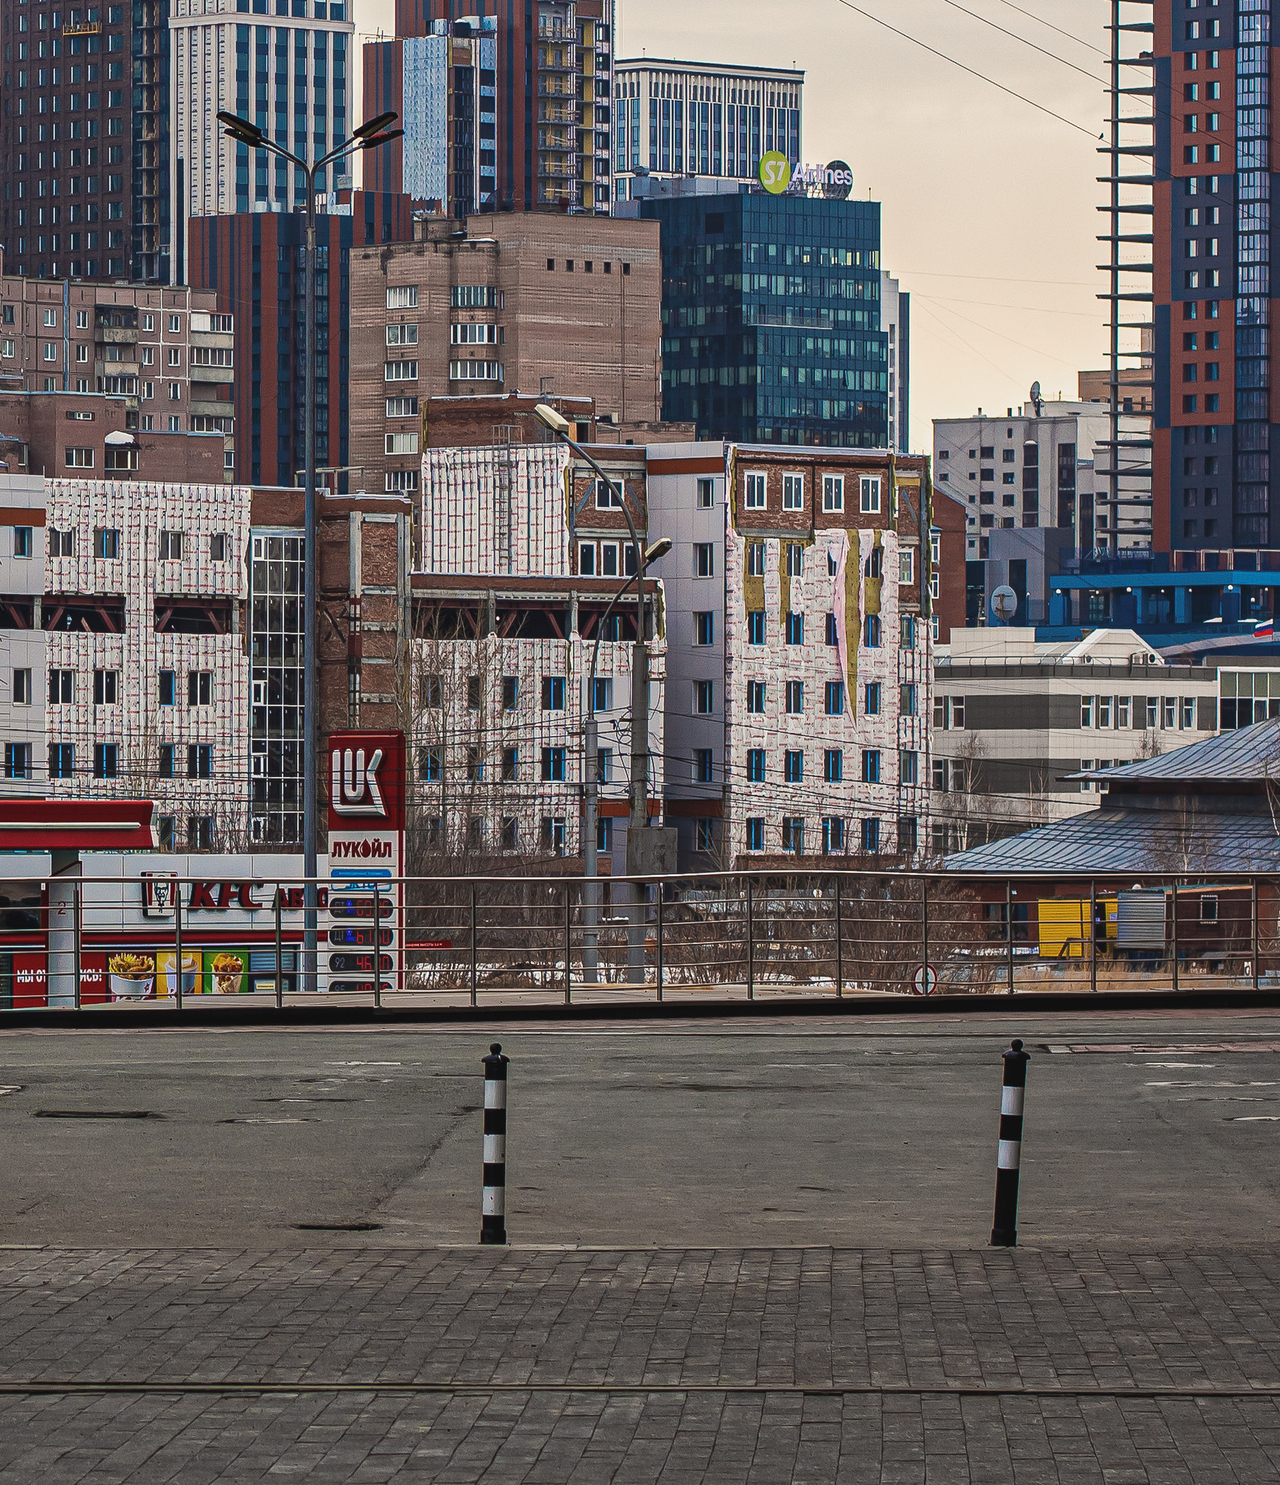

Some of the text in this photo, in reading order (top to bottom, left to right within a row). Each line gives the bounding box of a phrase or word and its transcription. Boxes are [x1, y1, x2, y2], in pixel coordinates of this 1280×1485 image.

[764, 160, 853, 186] S7 Airlines
[332, 838, 393, 858] ЛУКОЙЛ
[189, 877, 329, 909] KFC АВО
[57, 901, 67, 915] 2
